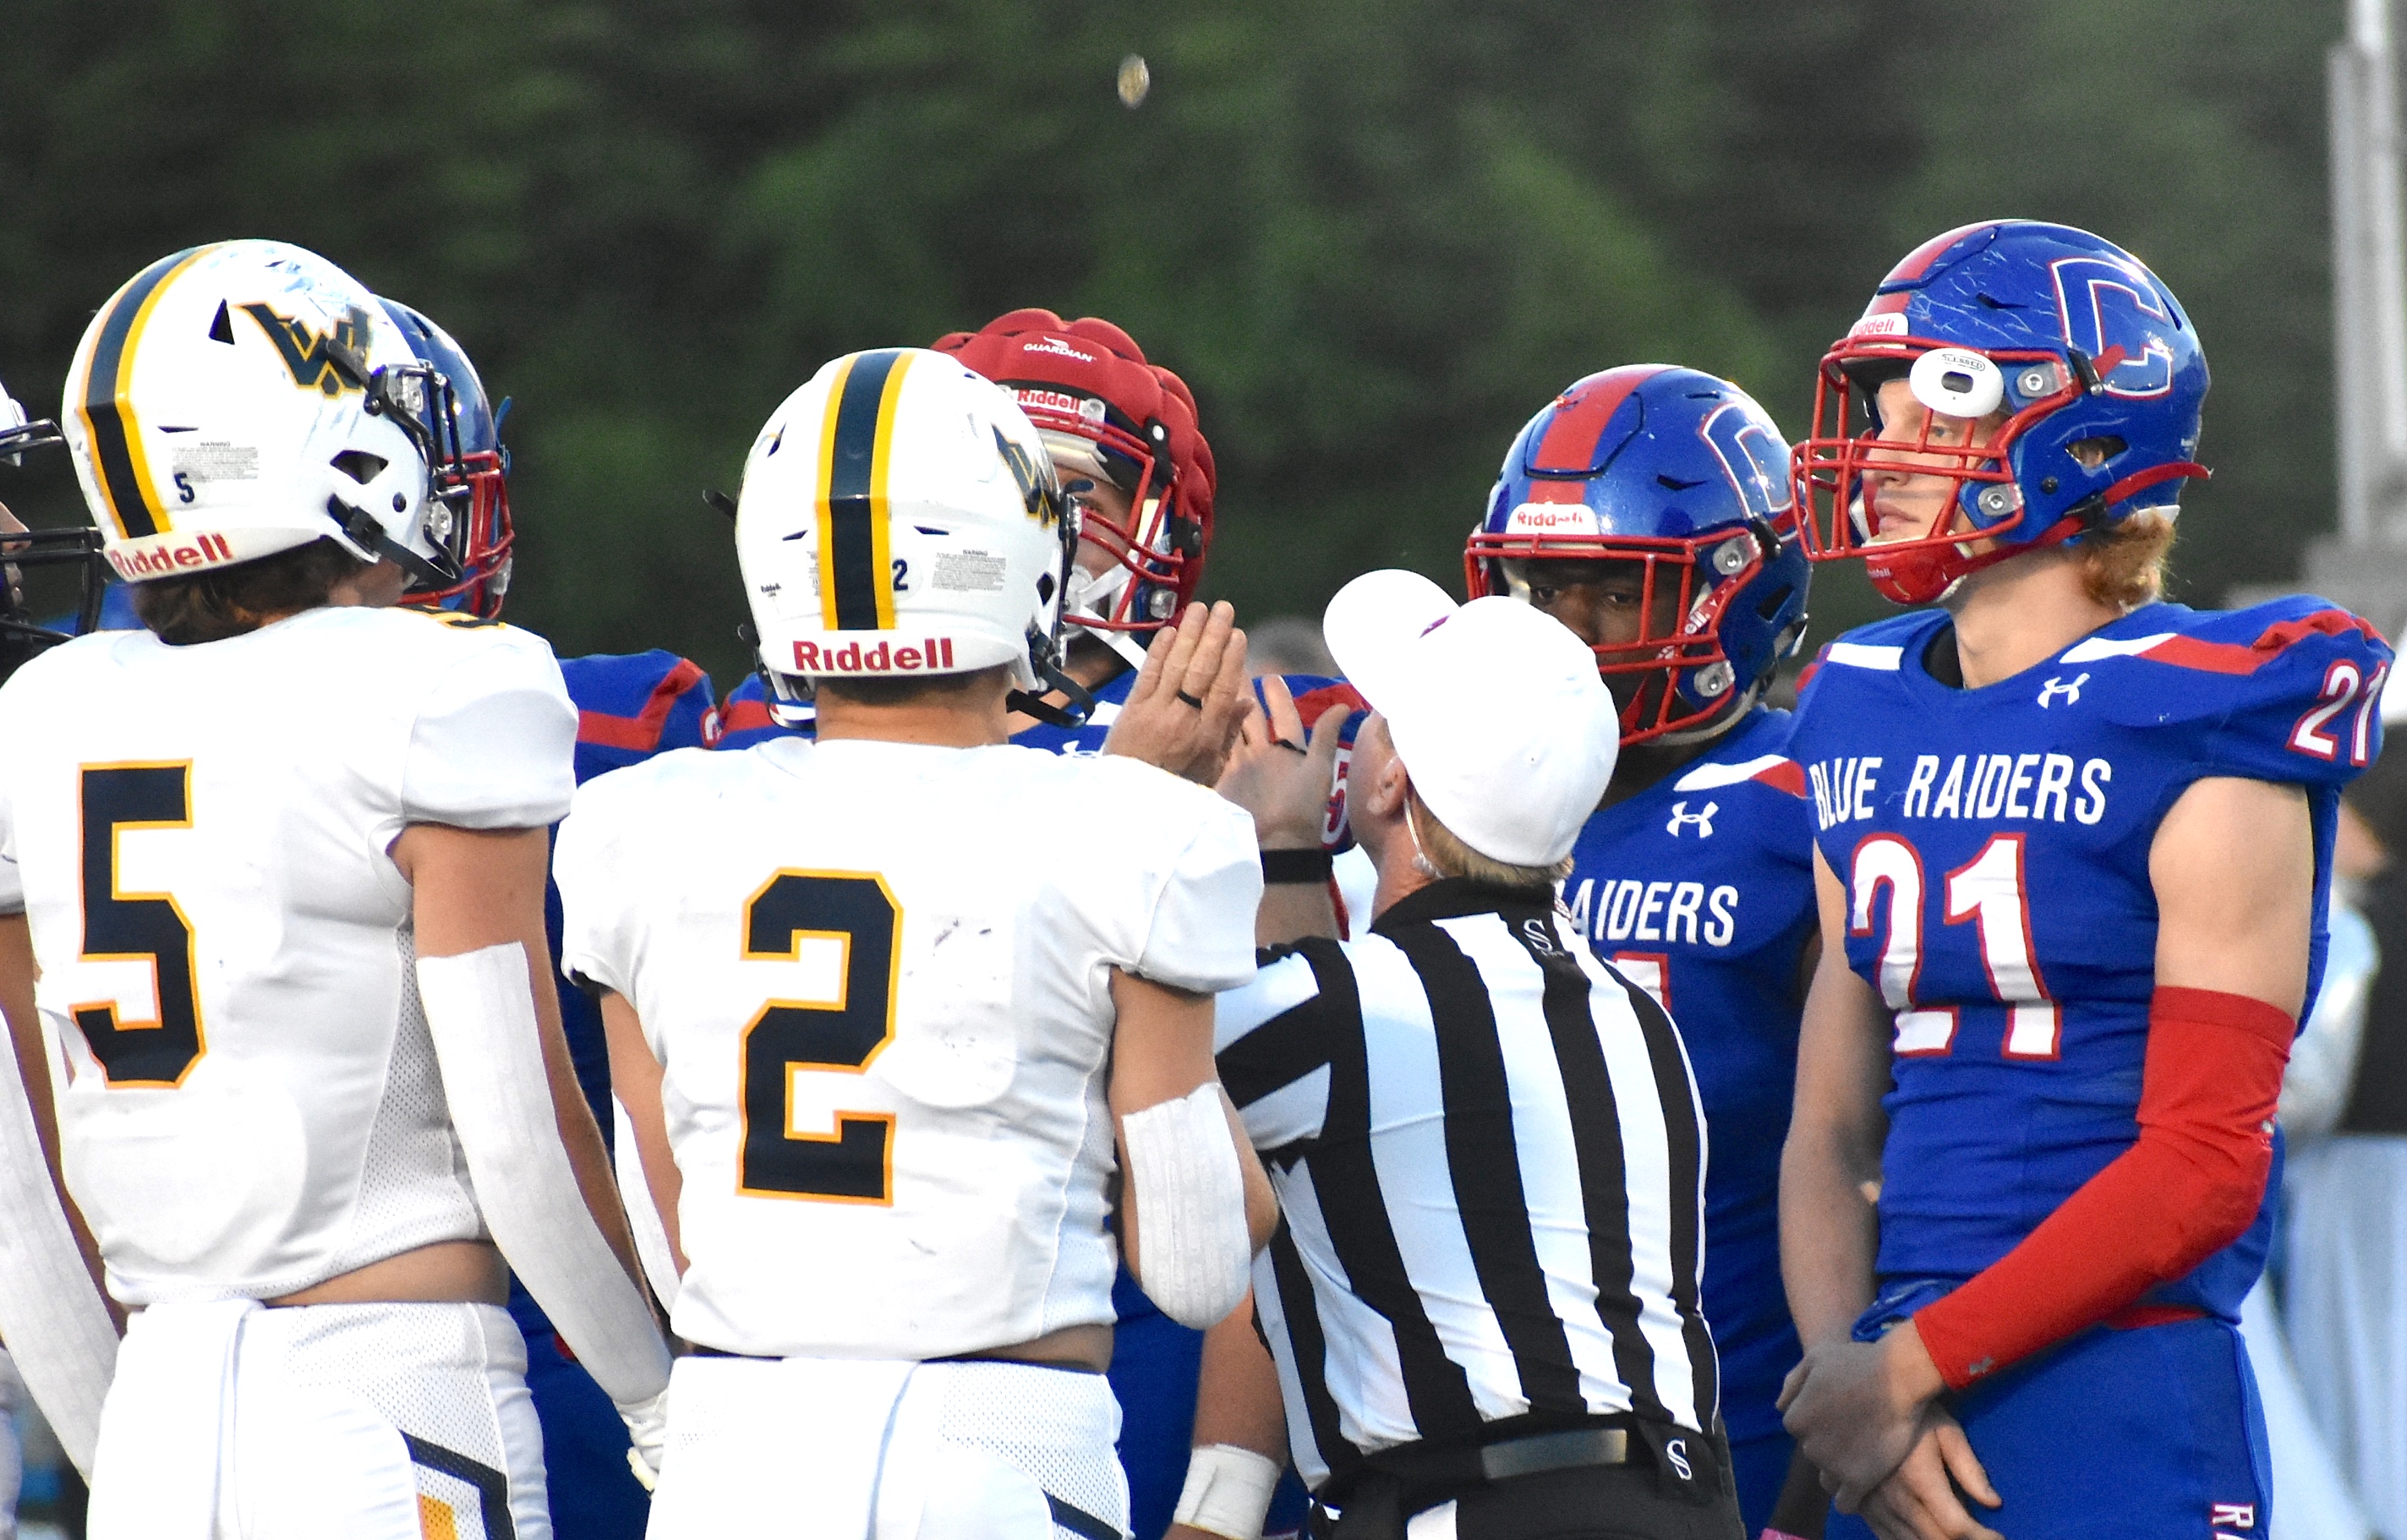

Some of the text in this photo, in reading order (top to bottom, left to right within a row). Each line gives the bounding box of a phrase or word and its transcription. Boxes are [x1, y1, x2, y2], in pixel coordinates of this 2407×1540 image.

[1023, 343, 1093, 363] GUARDIAN
[1017, 389, 1081, 412] Riddell
[173, 472, 195, 503] 5
[109, 533, 232, 577] Riddell
[892, 559, 909, 591] 2
[793, 637, 954, 671] Riddell
[2285, 658, 2388, 767] 21
[1808, 753, 2112, 831] BLUE RAIDERS
[68, 758, 207, 1089] 5
[1554, 878, 1738, 947] AIDERS
[1524, 918, 1553, 951] S
[1851, 832, 2063, 1061] 21
[735, 866, 904, 1208] 2
[1666, 1439, 1692, 1481] S
